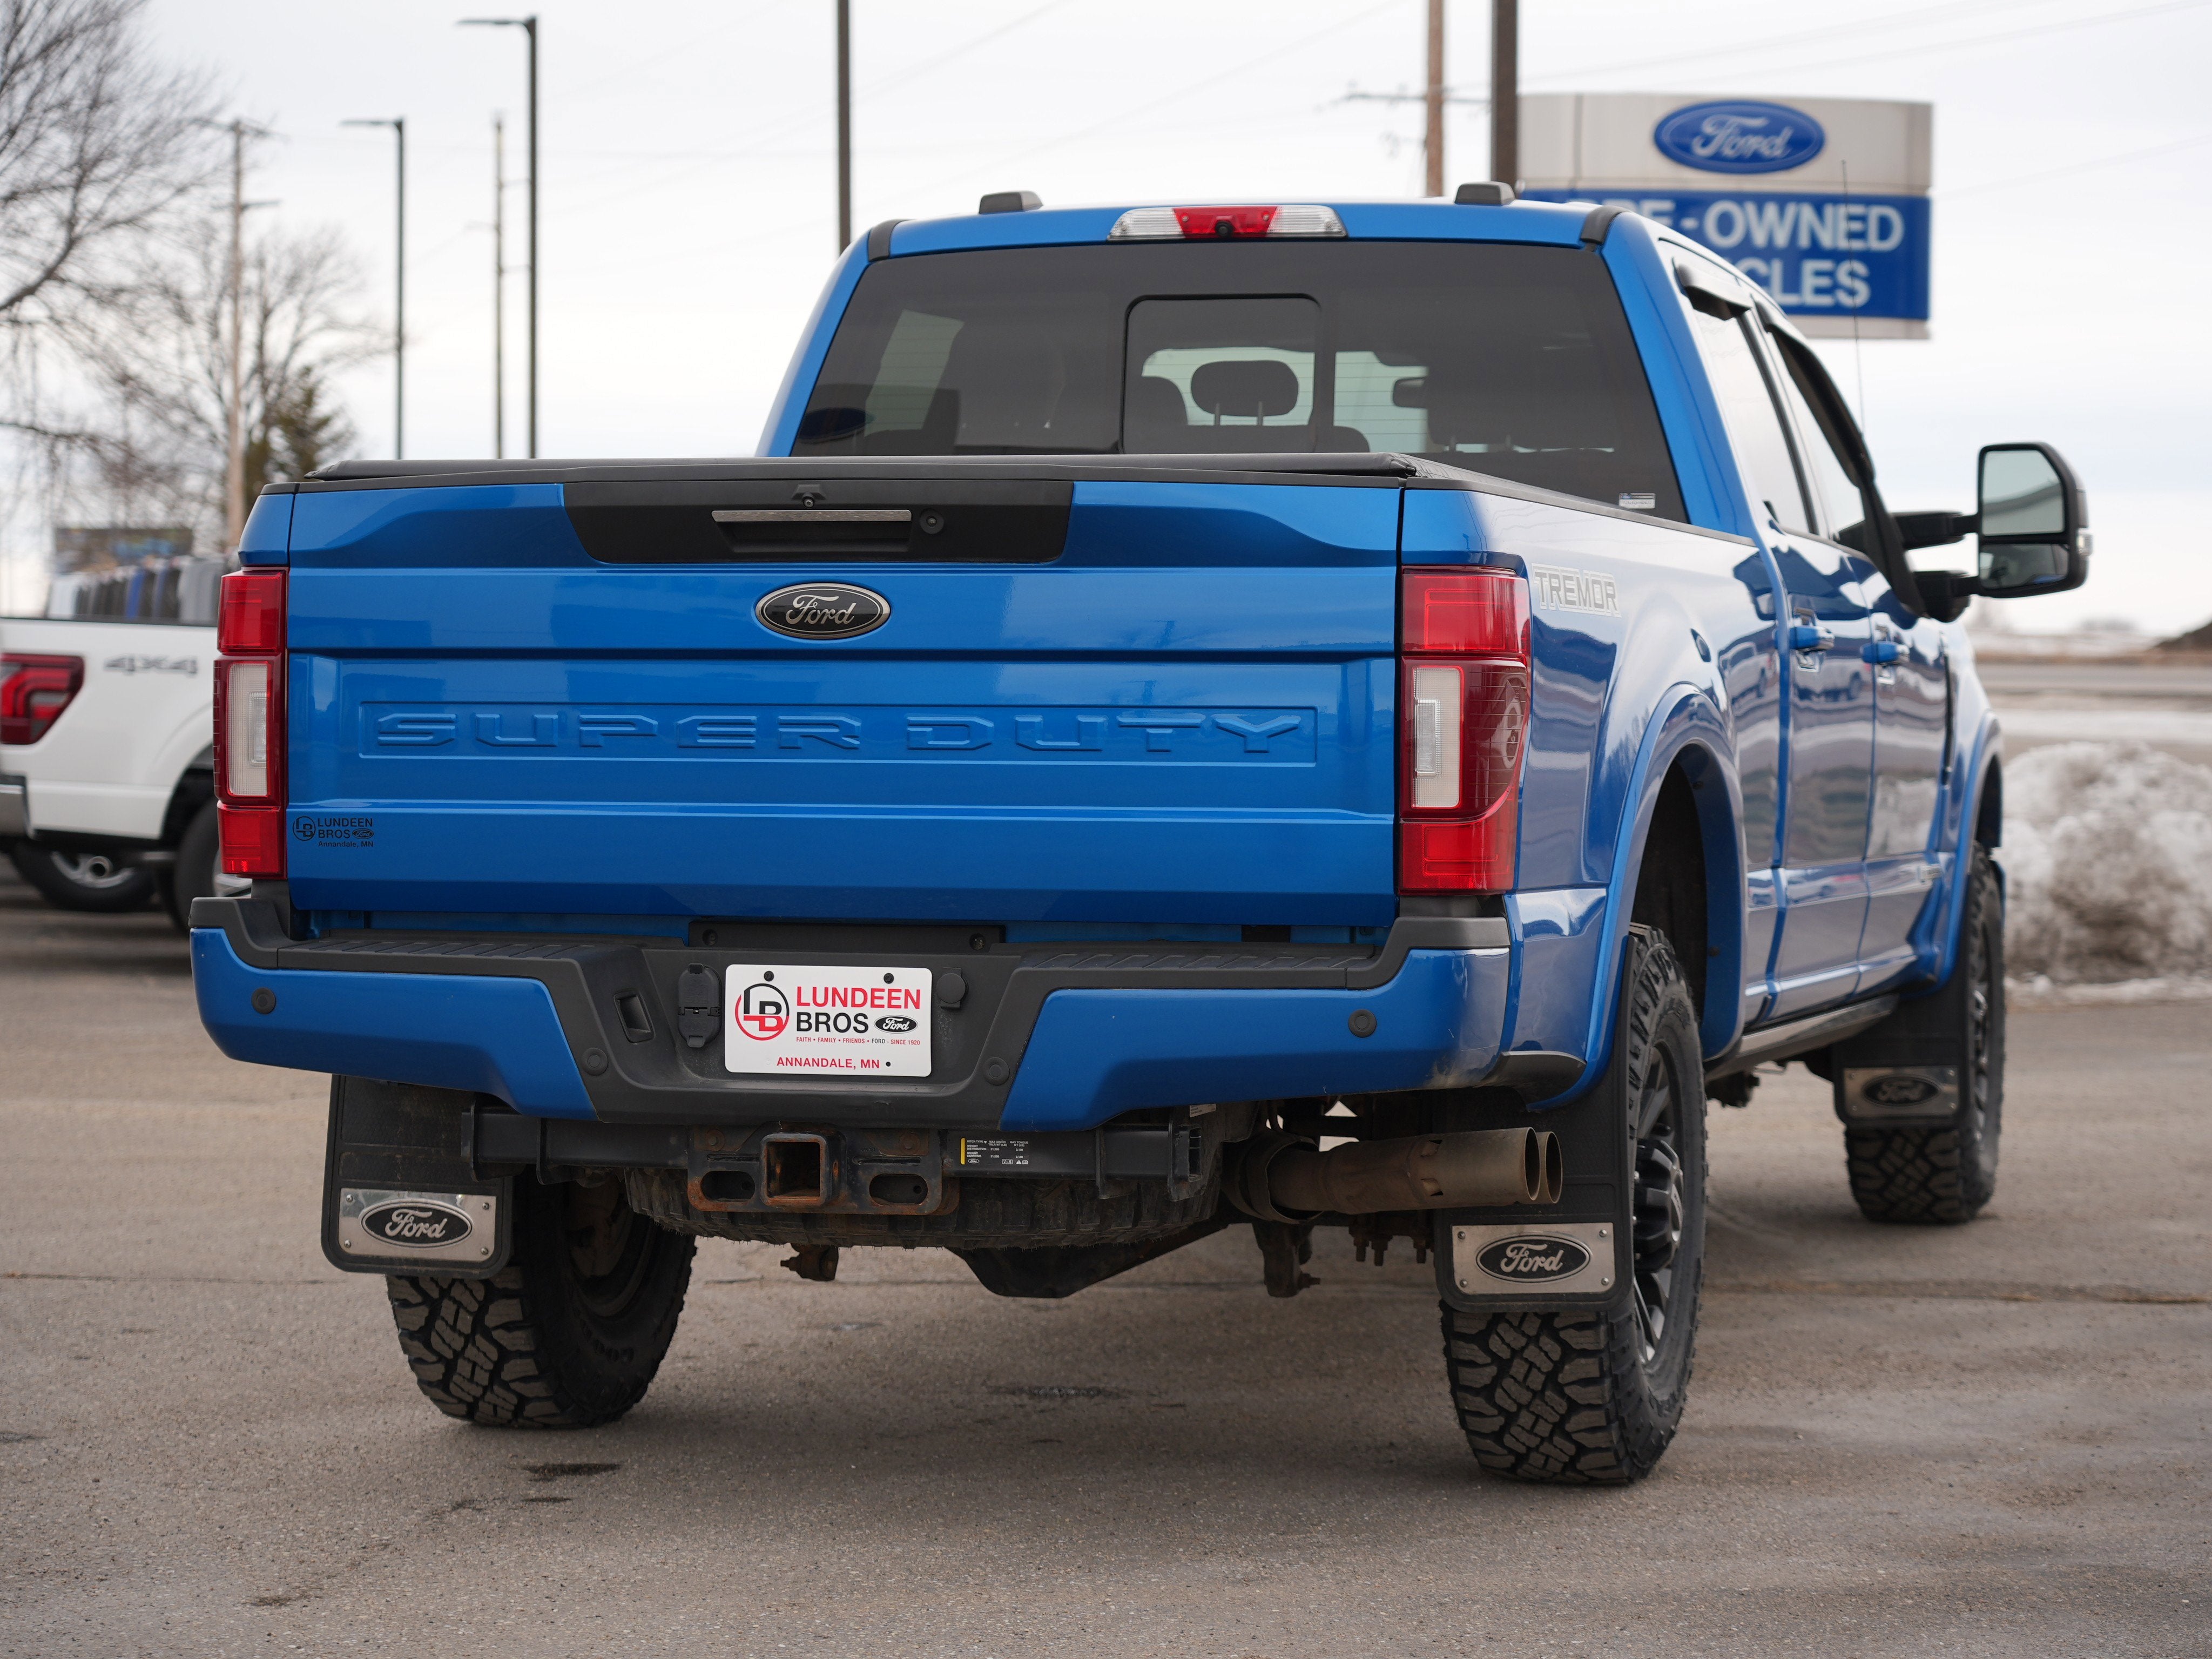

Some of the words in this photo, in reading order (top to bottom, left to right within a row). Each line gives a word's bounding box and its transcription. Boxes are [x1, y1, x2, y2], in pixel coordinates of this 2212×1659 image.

[1691, 114, 1794, 158] Ford
[1533, 565, 1621, 617] TREMOR
[785, 595, 856, 624] Ford
[377, 713, 861, 749] SUPER
[906, 714, 1301, 752] DUTY
[318, 818, 373, 827] LUNDEEN
[318, 830, 350, 839] BROS
[796, 986, 920, 1009] LUNDEEN
[796, 1011, 868, 1033] BROS
[882, 1017, 910, 1031] Ford
[777, 1057, 857, 1069] ANNANDALE,
[861, 1059, 880, 1068] MN
[385, 1209, 447, 1238] Ford
[1500, 1243, 1564, 1273] Ford
